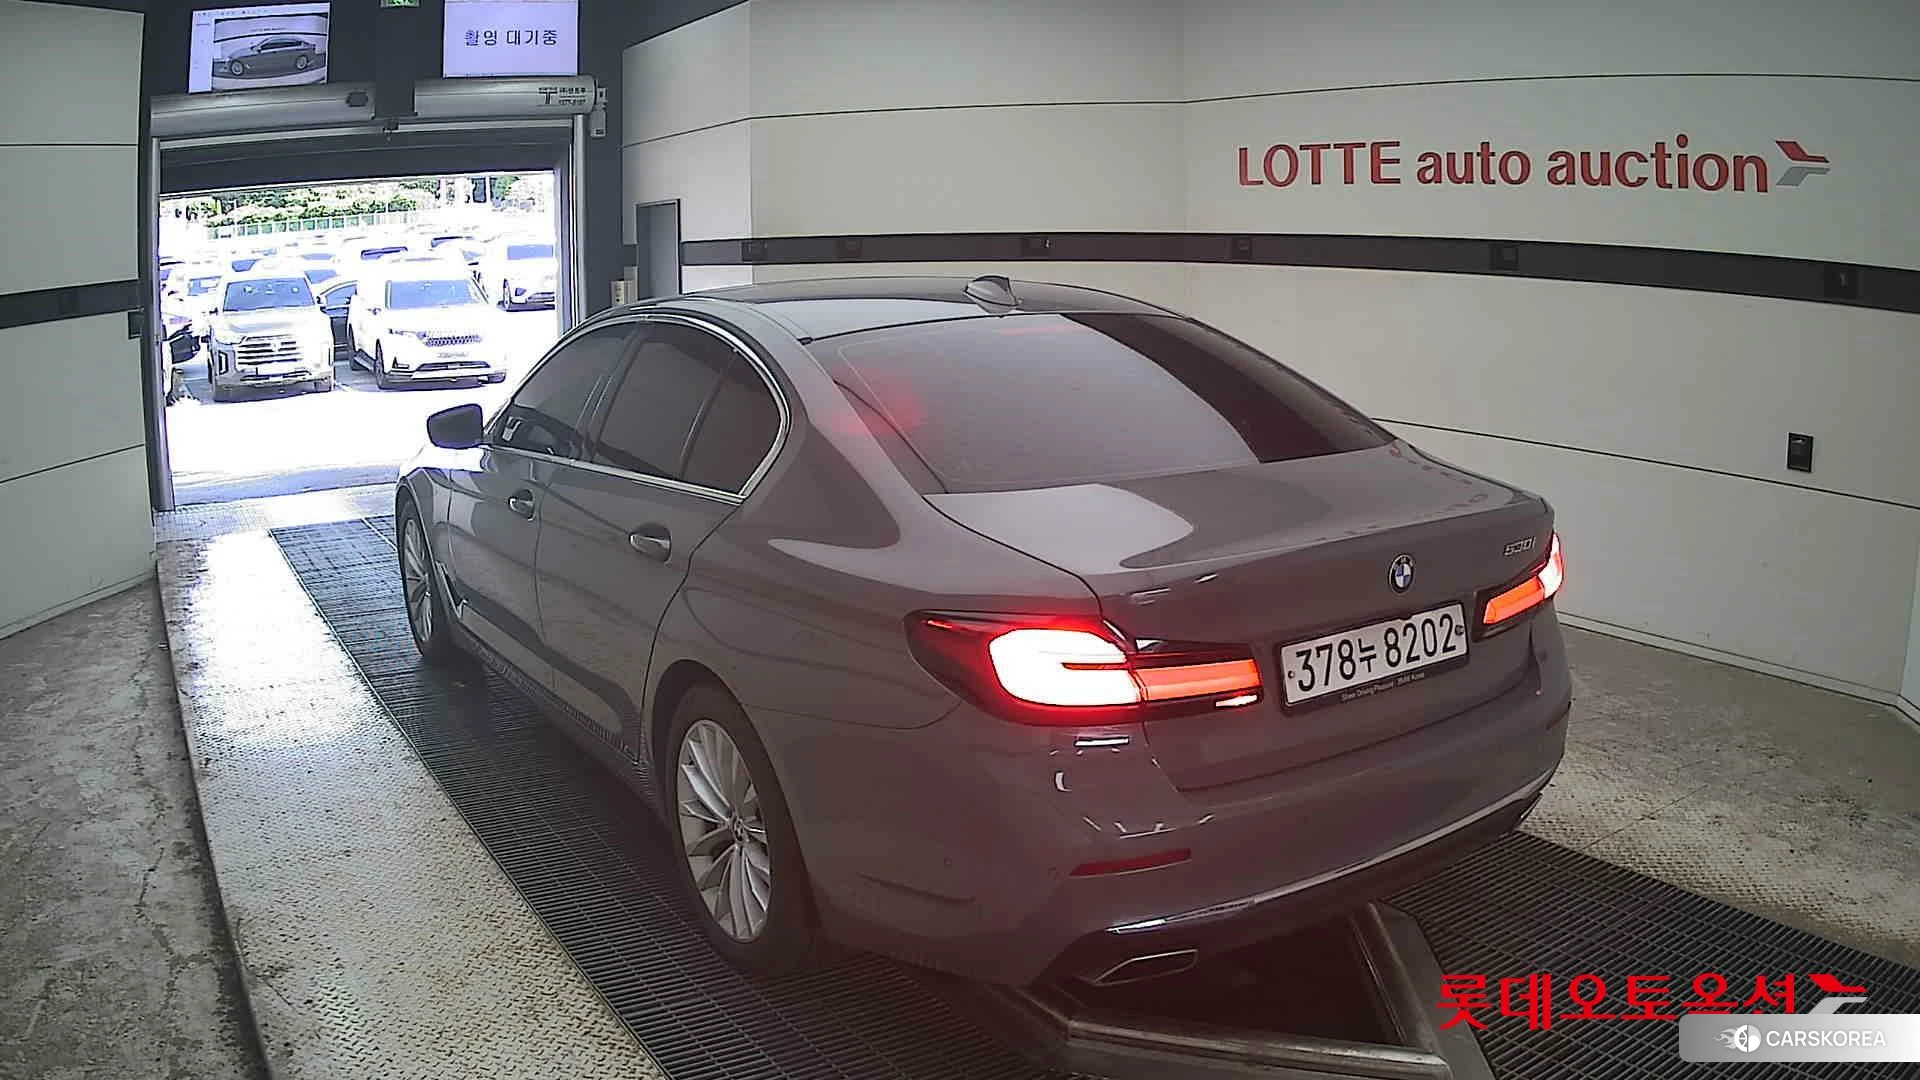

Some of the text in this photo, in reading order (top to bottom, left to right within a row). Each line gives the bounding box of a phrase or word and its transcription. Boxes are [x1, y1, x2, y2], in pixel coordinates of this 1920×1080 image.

[506, 30, 558, 46] 대기중
[1238, 133, 1769, 193] LOTTE auto auction
